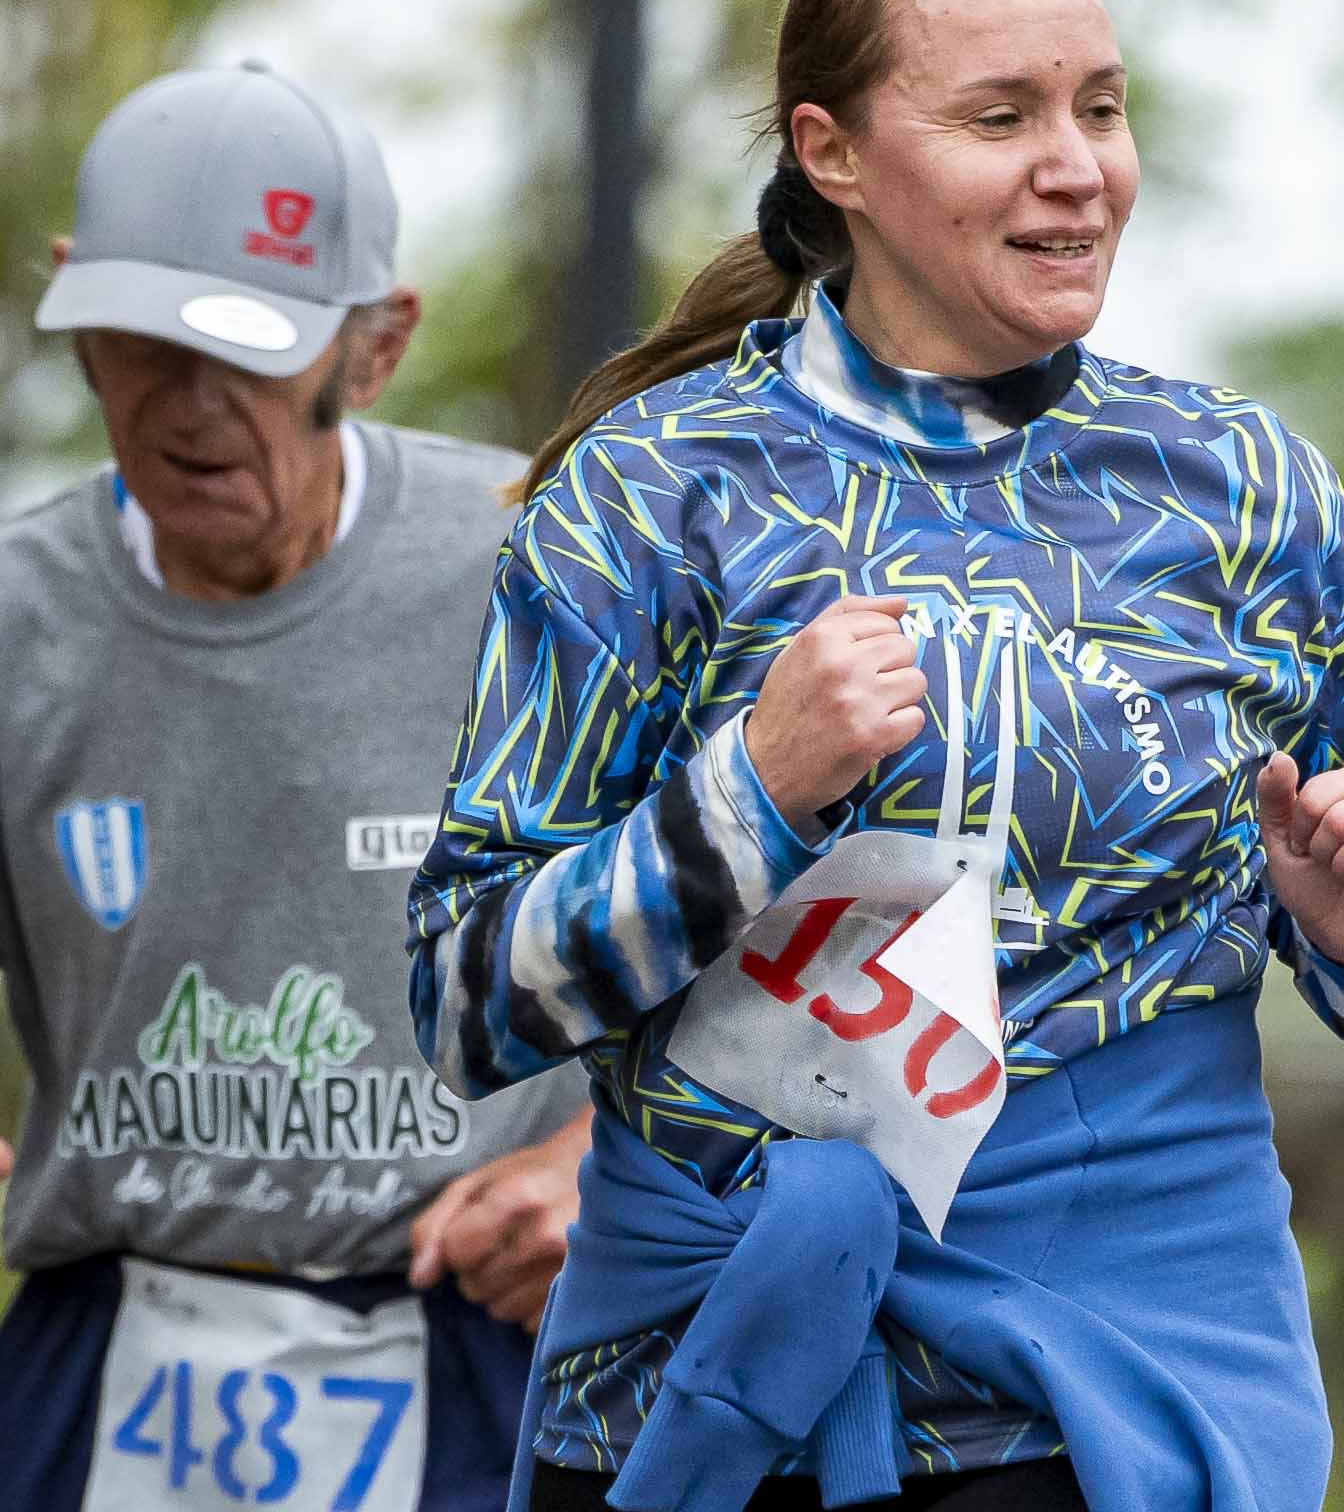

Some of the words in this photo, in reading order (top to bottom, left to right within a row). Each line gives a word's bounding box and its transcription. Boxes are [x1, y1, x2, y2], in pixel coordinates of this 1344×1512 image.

[948, 604, 981, 635] X
[993, 607, 1037, 645] EL
[1046, 627, 1172, 796] AUTISMO
